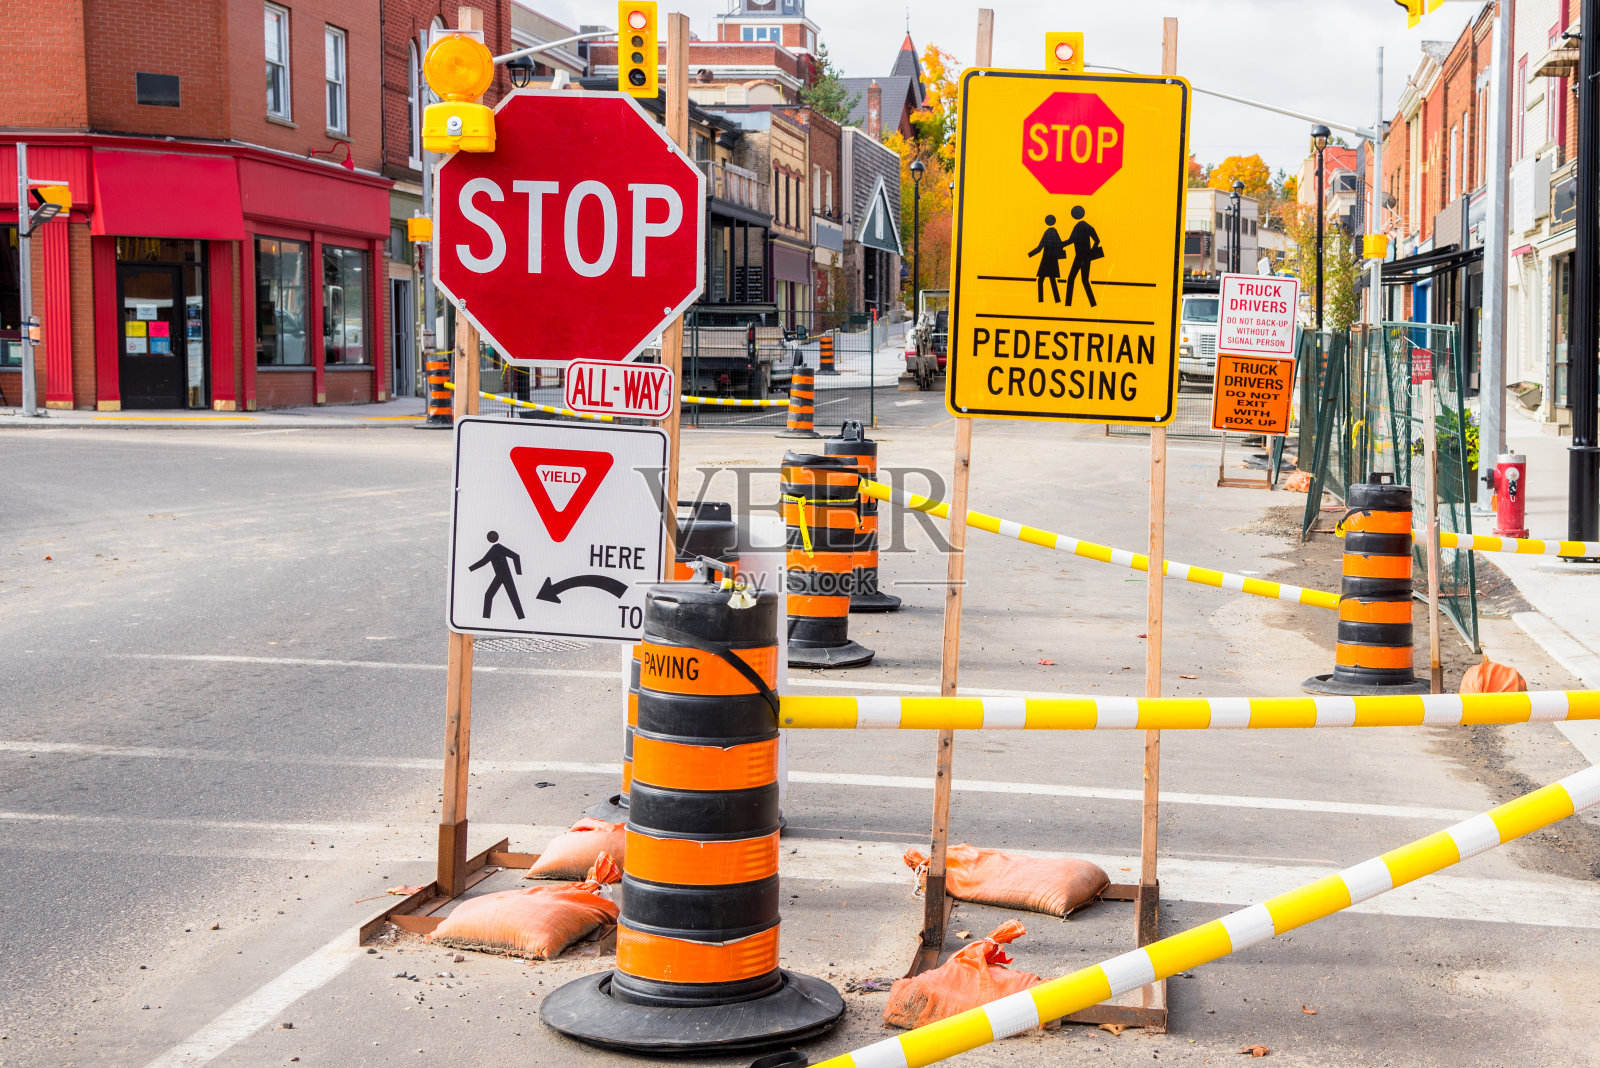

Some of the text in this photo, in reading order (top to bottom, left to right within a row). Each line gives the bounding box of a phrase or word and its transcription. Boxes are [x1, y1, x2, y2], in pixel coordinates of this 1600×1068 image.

[1027, 122, 1119, 164] STOP
[455, 177, 684, 278] STOP
[1238, 283, 1282, 298] TRUCK
[1230, 298, 1287, 314] DRIVERS
[1226, 316, 1289, 327] DO NOT BACK-UP
[1236, 327, 1277, 337] WITHOUT A
[972, 327, 1155, 365] PEDESTRIAN
[1227, 336, 1286, 347] SIGNAL PERSON
[1232, 361, 1278, 376] TRUCK
[571, 367, 666, 411] ALL-WAY
[987, 366, 1138, 402] CROSSING
[1224, 375, 1284, 391] DRIVERS
[1225, 390, 1281, 401] DO NOT
[1237, 399, 1268, 408] EXIT
[1233, 408, 1271, 418] WITH
[1224, 416, 1277, 427] BOX UP
[541, 470, 581, 485] YIELD
[589, 544, 646, 571] HERE
[618, 605, 643, 630] TO
[643, 651, 700, 681] PAVING
